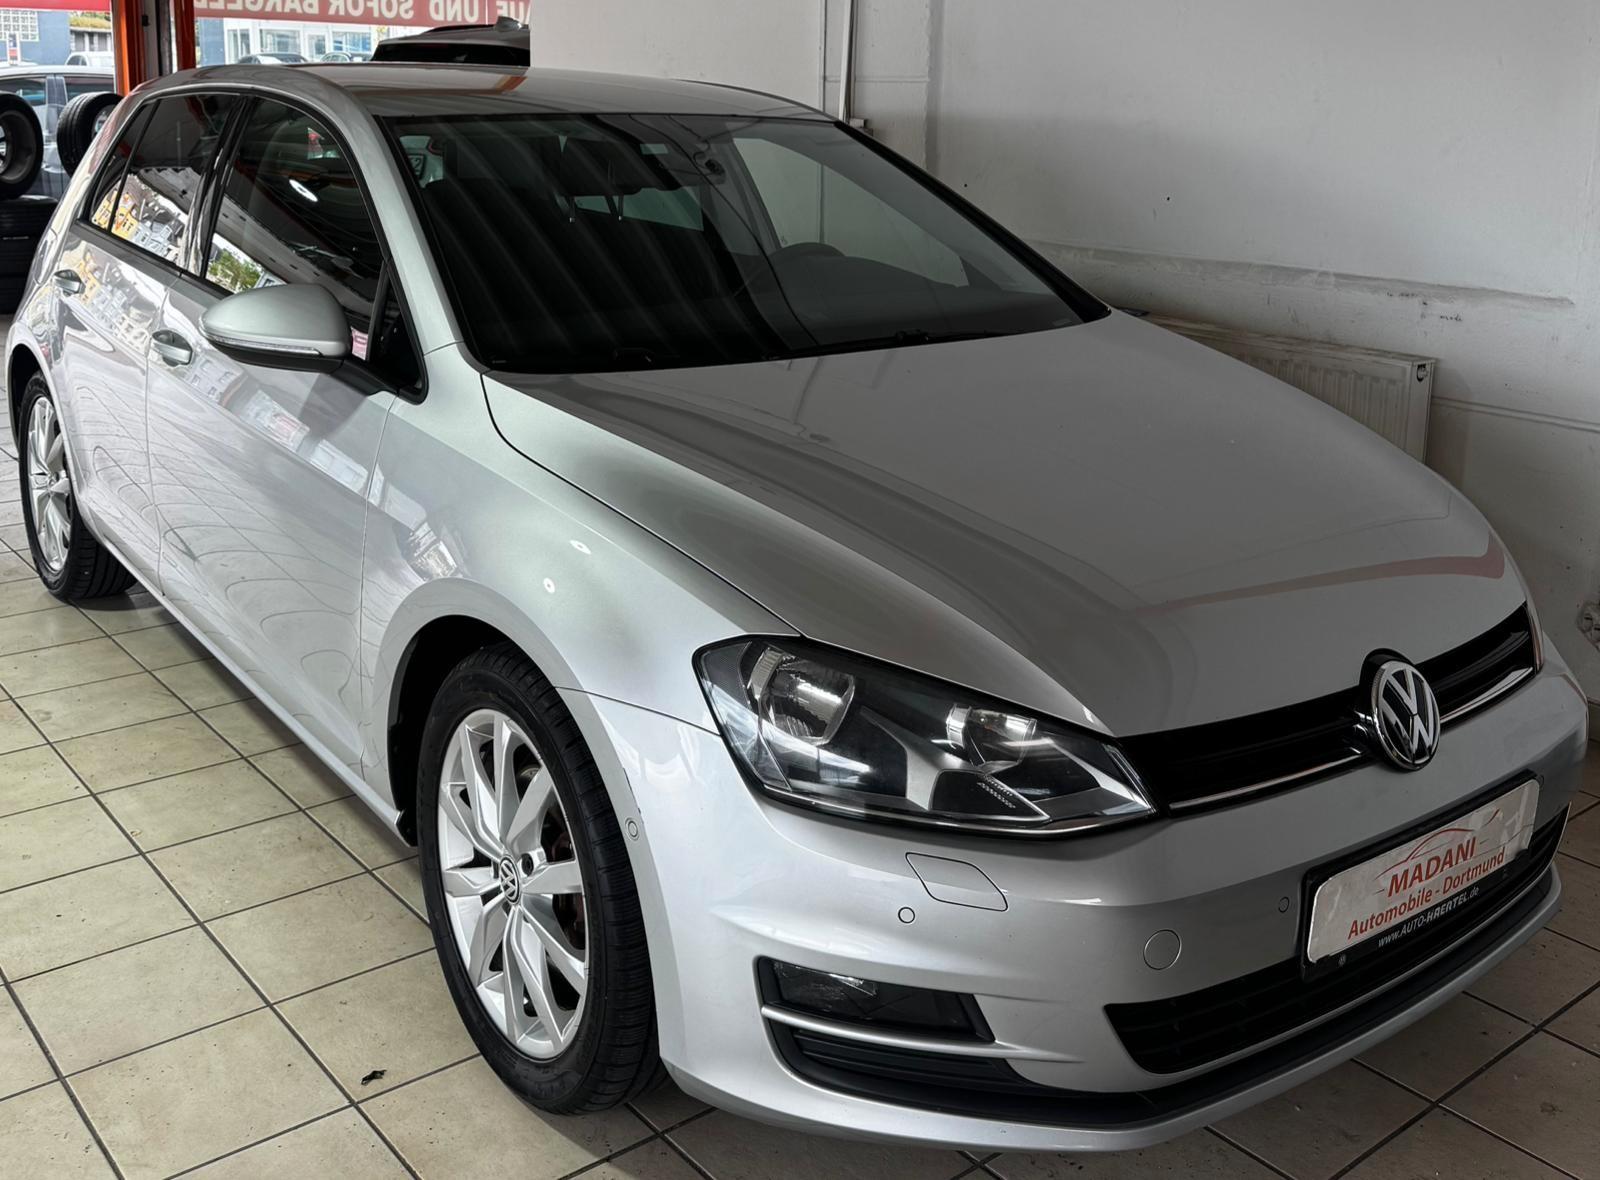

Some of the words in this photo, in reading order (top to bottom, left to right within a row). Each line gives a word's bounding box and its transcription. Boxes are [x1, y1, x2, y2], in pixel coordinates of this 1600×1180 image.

[1347, 887, 1433, 940] Automobile
[1442, 846, 1506, 895] Dortmund
[1387, 836, 1477, 898] MADANI
